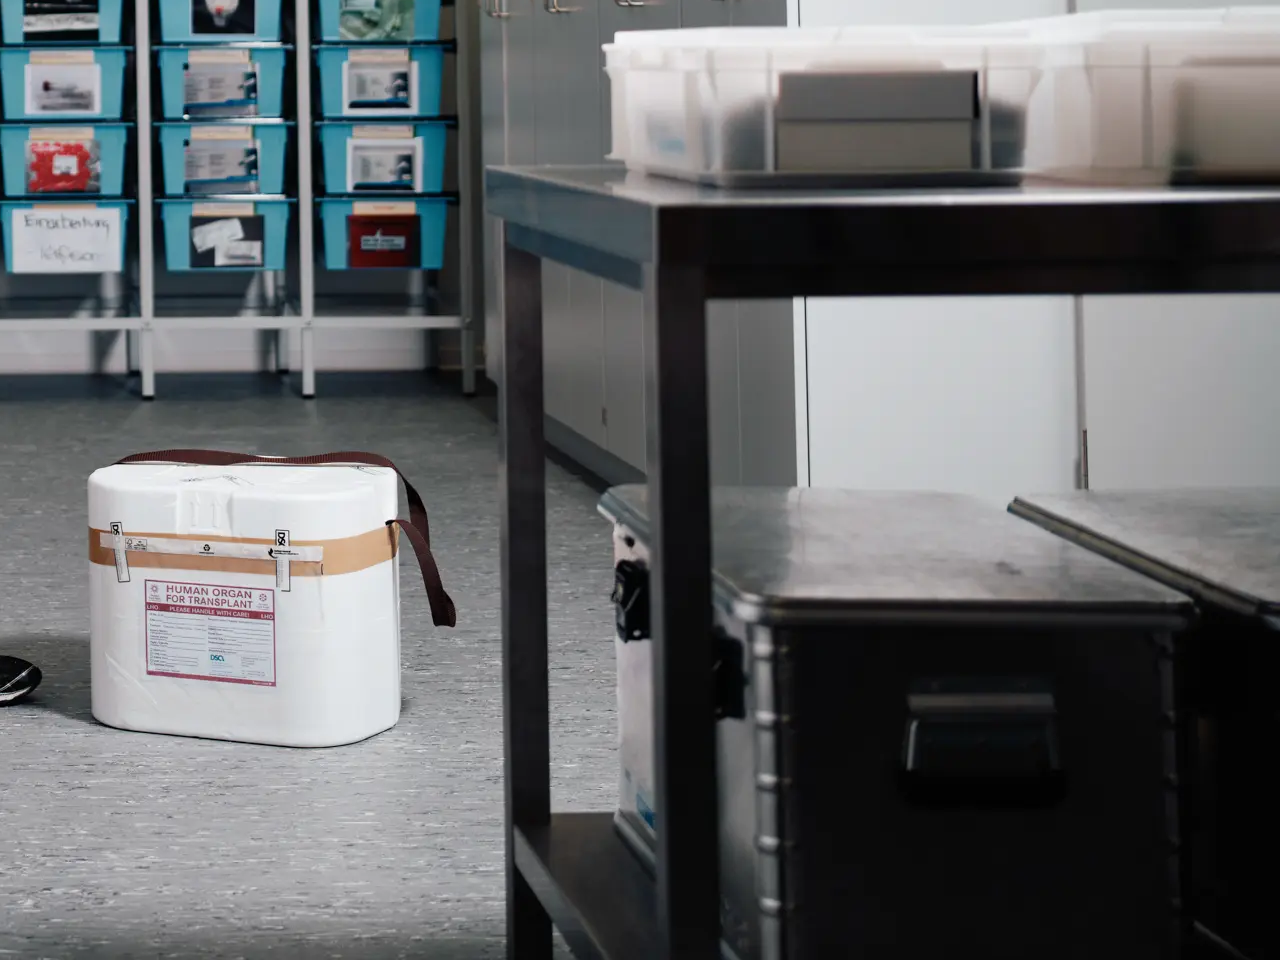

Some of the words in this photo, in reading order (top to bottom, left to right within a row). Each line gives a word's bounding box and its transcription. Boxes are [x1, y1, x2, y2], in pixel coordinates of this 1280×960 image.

[166, 584, 209, 596] HUMAN
[212, 588, 252, 599] ORGAN
[166, 594, 186, 604] FOR
[188, 596, 253, 609] TRANSPLANT
[191, 607, 215, 615] HANDLE
